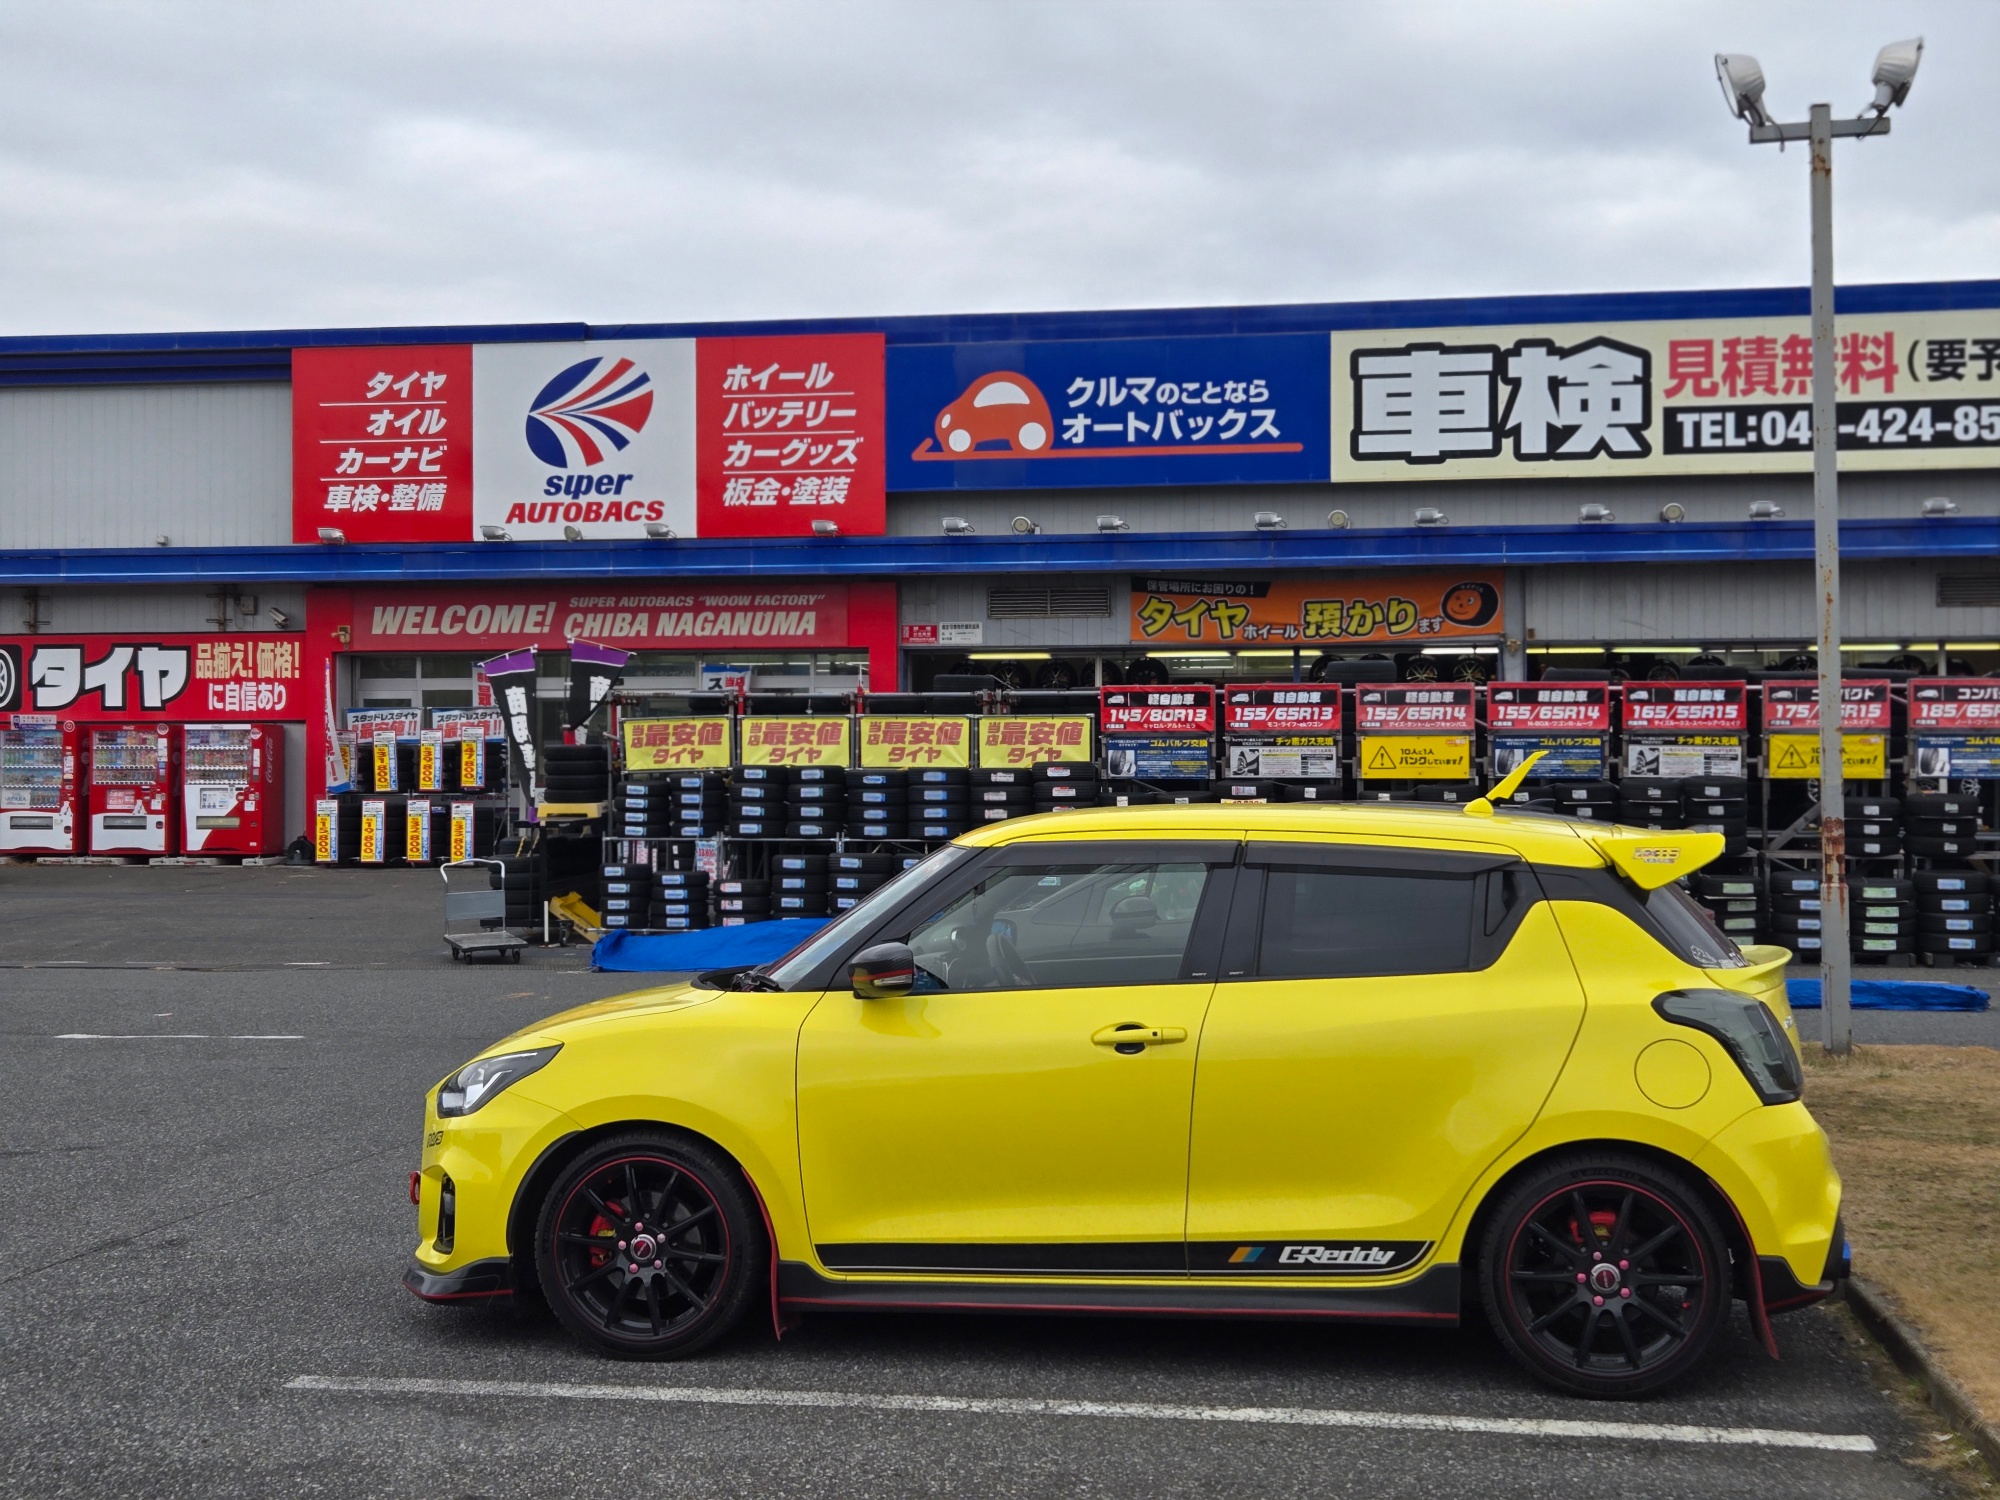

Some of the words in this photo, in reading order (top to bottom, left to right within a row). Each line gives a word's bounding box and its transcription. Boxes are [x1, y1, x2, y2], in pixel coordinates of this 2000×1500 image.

[722, 361, 834, 391] ホイール
[1662, 331, 1899, 399] 見積無料
[365, 370, 448, 399] タイヤ
[1066, 376, 1270, 408] クルマのことなら
[1350, 335, 1653, 464] 車検
[366, 408, 448, 436] オイル
[722, 400, 857, 429] バッテリー
[1062, 408, 1281, 444] オートバックス
[1677, 405, 2000, 450] TEL:04-424-85
[335, 444, 448, 475] カーナビ
[722, 437, 864, 467] カーグッズ
[323, 482, 448, 513] 車検・整備
[543, 473, 633, 500] super
[722, 476, 852, 507] 板金・塗装
[505, 500, 665, 524] AUTOBACS
[569, 596, 617, 608] SUPER
[619, 596, 695, 608] AUTOBACS
[371, 602, 556, 635] WELCOME!
[563, 612, 649, 638] CHIBA
[655, 610, 817, 638] NAGANUMA
[28, 643, 191, 711] タイヤ
[208, 681, 287, 711] に自信あり
[1811, 688, 1875, 700] コパクト
[1958, 687, 2000, 700] コンパ
[1110, 709, 1207, 722] 145/80R13
[1234, 707, 1334, 721] 155/65R13
[1366, 706, 1467, 720] 155/65R14
[1497, 705, 1600, 720] 155/65R14
[1633, 705, 1739, 719] 165/55R15
[644, 722, 724, 748] 最安値
[761, 721, 844, 746] 最安値
[881, 721, 964, 746] 最安値
[1000, 721, 1085, 746] 最安値
[652, 747, 704, 764] タイヤ
[768, 747, 822, 764] タイヤ
[888, 746, 942, 763] タイヤ
[1007, 746, 1062, 763] タイヤ
[1278, 1245, 1396, 1265] GReddy
